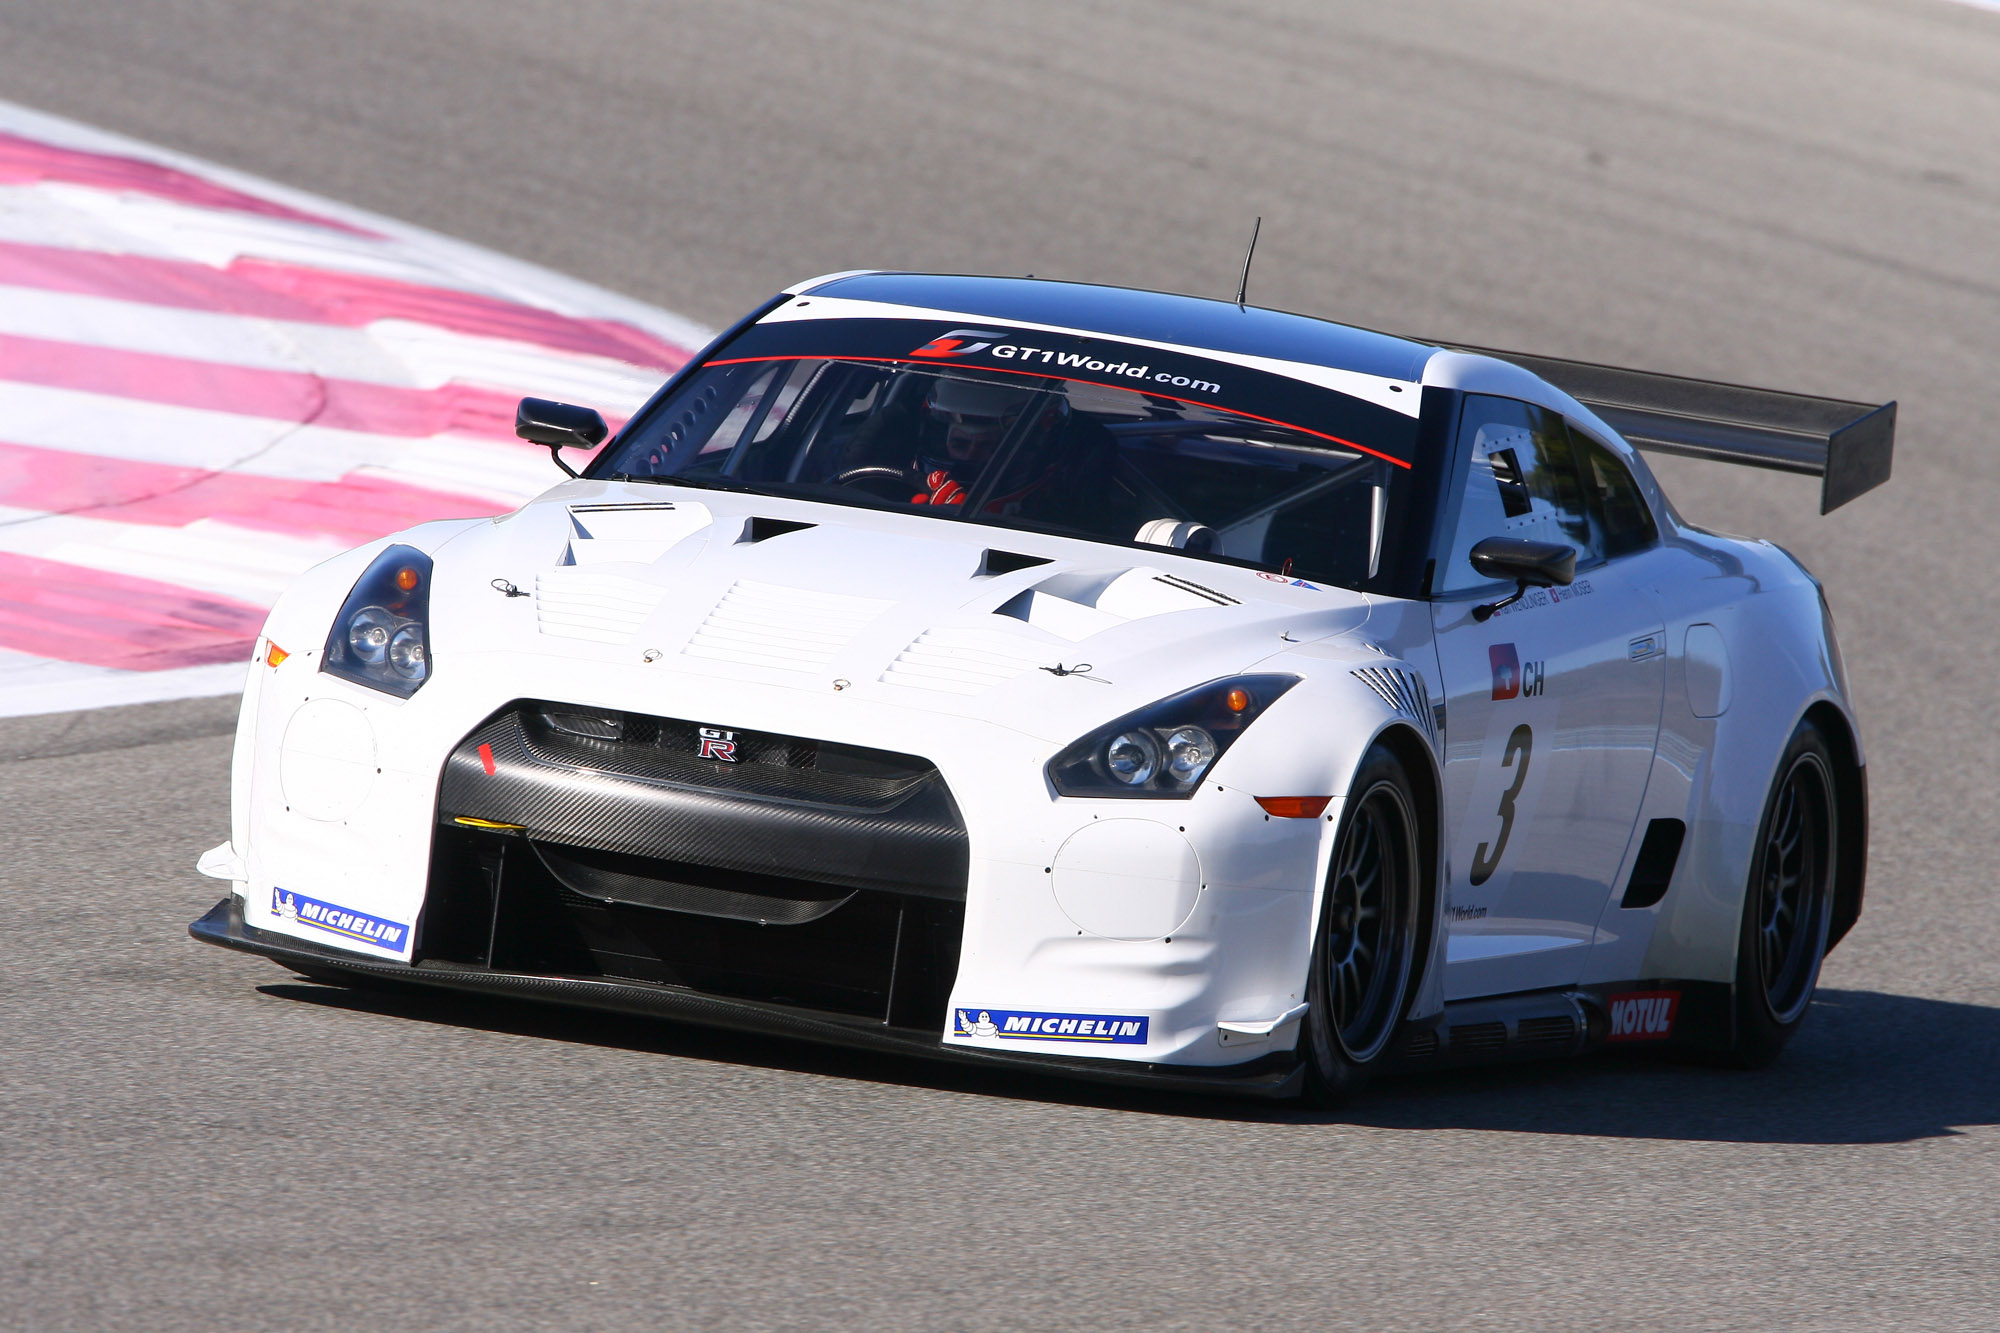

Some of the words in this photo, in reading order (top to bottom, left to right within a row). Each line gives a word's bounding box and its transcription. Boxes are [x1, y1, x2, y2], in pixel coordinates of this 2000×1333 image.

[991, 345, 1221, 394] GT1World.com
[1523, 661, 1545, 698] CH
[698, 738, 736, 762] R
[699, 727, 740, 740] GT
[1470, 724, 1533, 887] 3
[300, 902, 403, 943] MICHELIN
[1003, 1016, 1142, 1036] MICHELIN
[1611, 998, 1672, 1035] MOTUL
